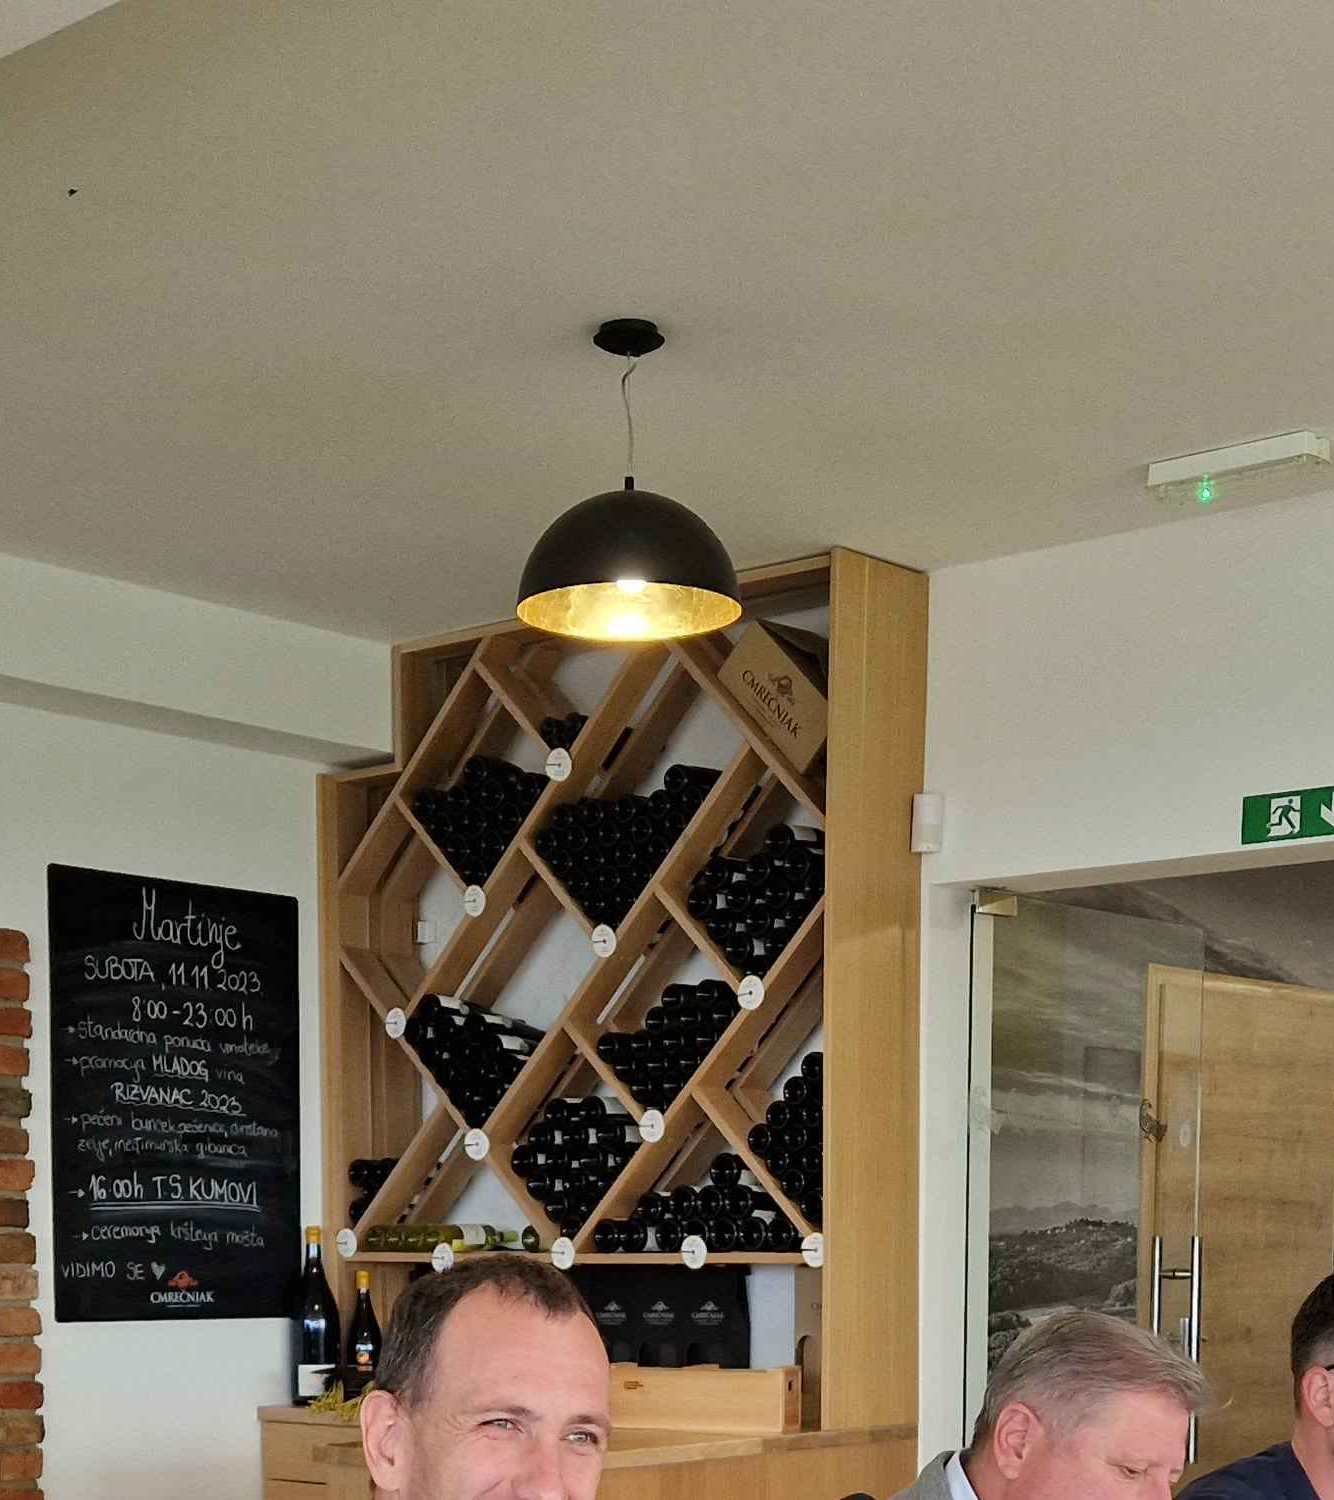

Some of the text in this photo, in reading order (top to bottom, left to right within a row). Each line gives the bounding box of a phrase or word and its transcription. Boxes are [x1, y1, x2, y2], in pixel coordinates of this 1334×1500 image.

[132, 886, 242, 969] Martinje
[152, 1054, 209, 1082] MLADOG
[110, 1081, 244, 1114] RIZVANAC 2023
[188, 1175, 259, 1206] KUMOVI
[60, 1260, 146, 1281] VIDIMO SE
